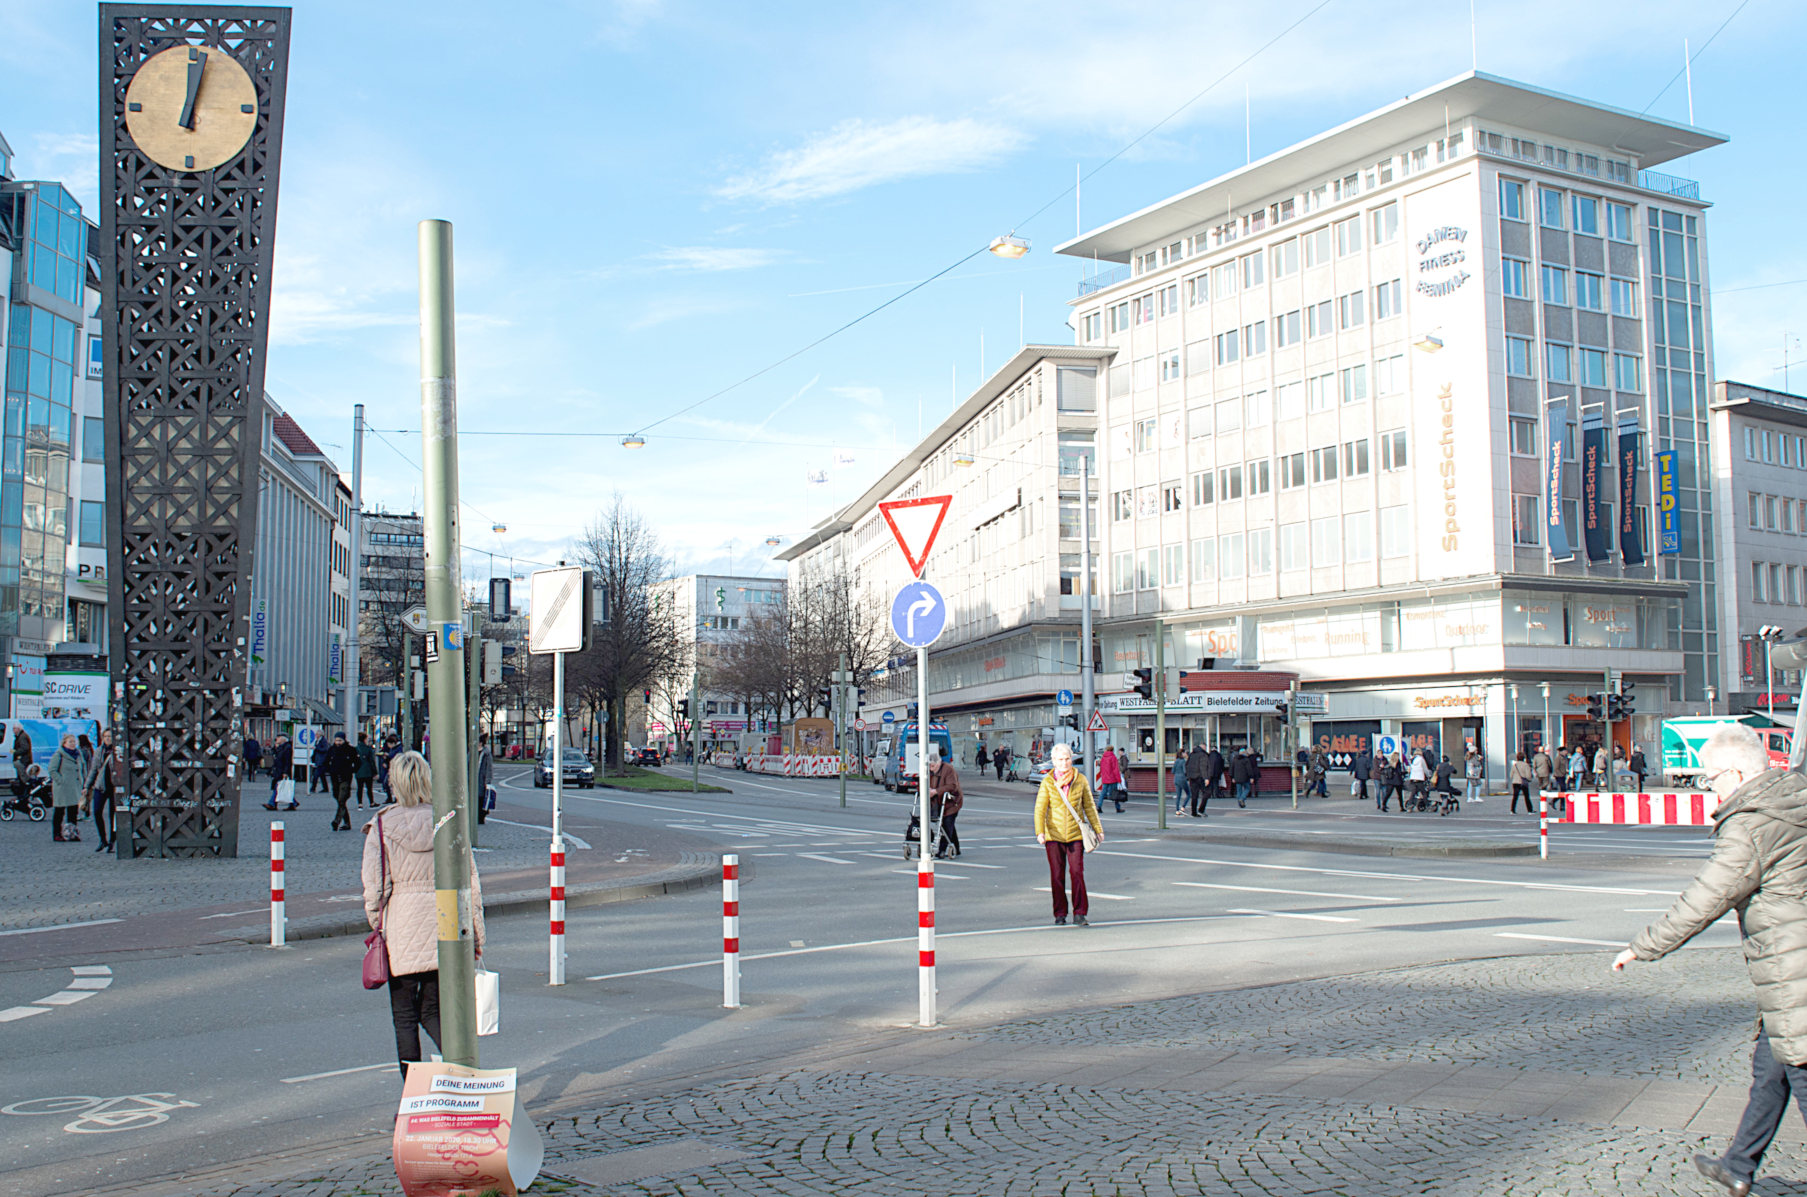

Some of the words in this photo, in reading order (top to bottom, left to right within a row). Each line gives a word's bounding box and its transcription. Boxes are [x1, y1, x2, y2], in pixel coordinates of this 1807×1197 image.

[1416, 226, 1468, 255] DAMEN
[1419, 249, 1466, 272] FITNESS
[1437, 382, 1461, 552] SportScheck
[1550, 440, 1562, 527] SportScheck
[1586, 445, 1597, 530] SportScheck
[1623, 450, 1634, 534] SportScheck
[1586, 606, 1616, 624] Sport
[1324, 630, 1369, 646] Running
[1445, 624, 1487, 637] Outdoor
[58, 684, 92, 694] DRIVE
[1206, 697, 1252, 706] Bielefelder
[1255, 697, 1283, 707] Zeitung
[1414, 694, 1483, 710] SportScheck
[436, 1079, 464, 1089] DEINE
[463, 1080, 505, 1090] MEINUNG
[410, 1100, 424, 1109] IST
[426, 1098, 480, 1108] PROGRAMM
